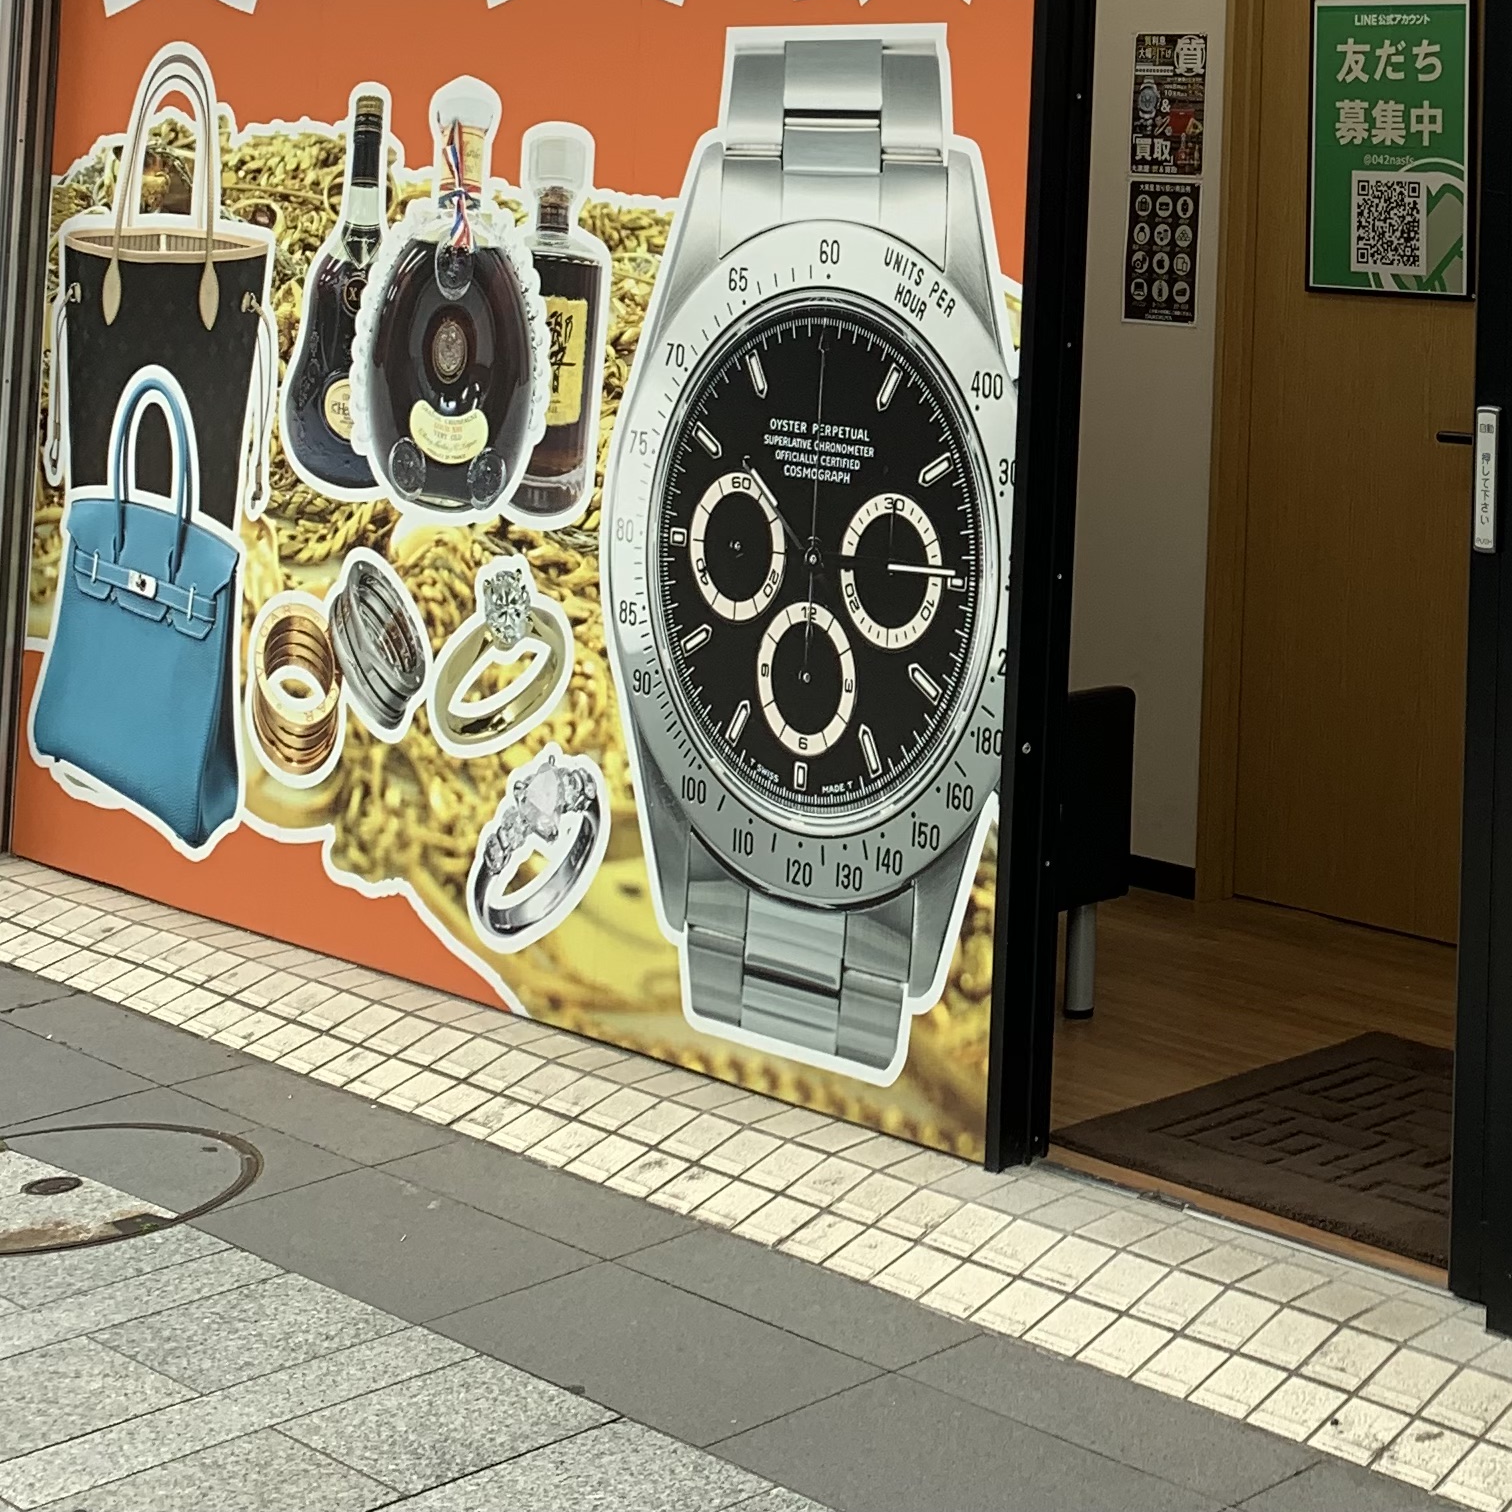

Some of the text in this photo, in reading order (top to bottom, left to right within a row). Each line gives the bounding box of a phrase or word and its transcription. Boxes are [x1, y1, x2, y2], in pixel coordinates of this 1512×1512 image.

[1335, 37, 1443, 83] 友だち
[1335, 99, 1443, 146] 募集中
[820, 239, 841, 265] 60
[728, 267, 749, 292] 65
[884, 246, 957, 319] UNITS PER
[895, 283, 929, 322] HOUR
[665, 344, 685, 368] 70
[971, 371, 1004, 401] 400
[769, 418, 870, 442] OYSTER PERPETUAL
[629, 430, 648, 457] 75
[763, 434, 875, 457] SUPERLATIVE CHRONOMETER
[775, 449, 861, 470] OFFICIALLY CERTIFIED
[731, 476, 751, 490] 60
[783, 464, 851, 484] COSMOGRAPH
[884, 497, 905, 512] 30
[615, 518, 634, 543] 80
[618, 601, 637, 626] 85
[633, 670, 652, 695] 90
[798, 737, 808, 750] 6
[975, 728, 1003, 756] 180
[756, 763, 780, 783] SWISS
[681, 775, 707, 805] 100
[822, 783, 846, 793] MADE
[946, 783, 973, 812] 160
[732, 828, 754, 856] 110
[911, 821, 940, 850] 150
[786, 858, 813, 887] 120
[875, 845, 903, 876] 140
[836, 863, 863, 891] 130
